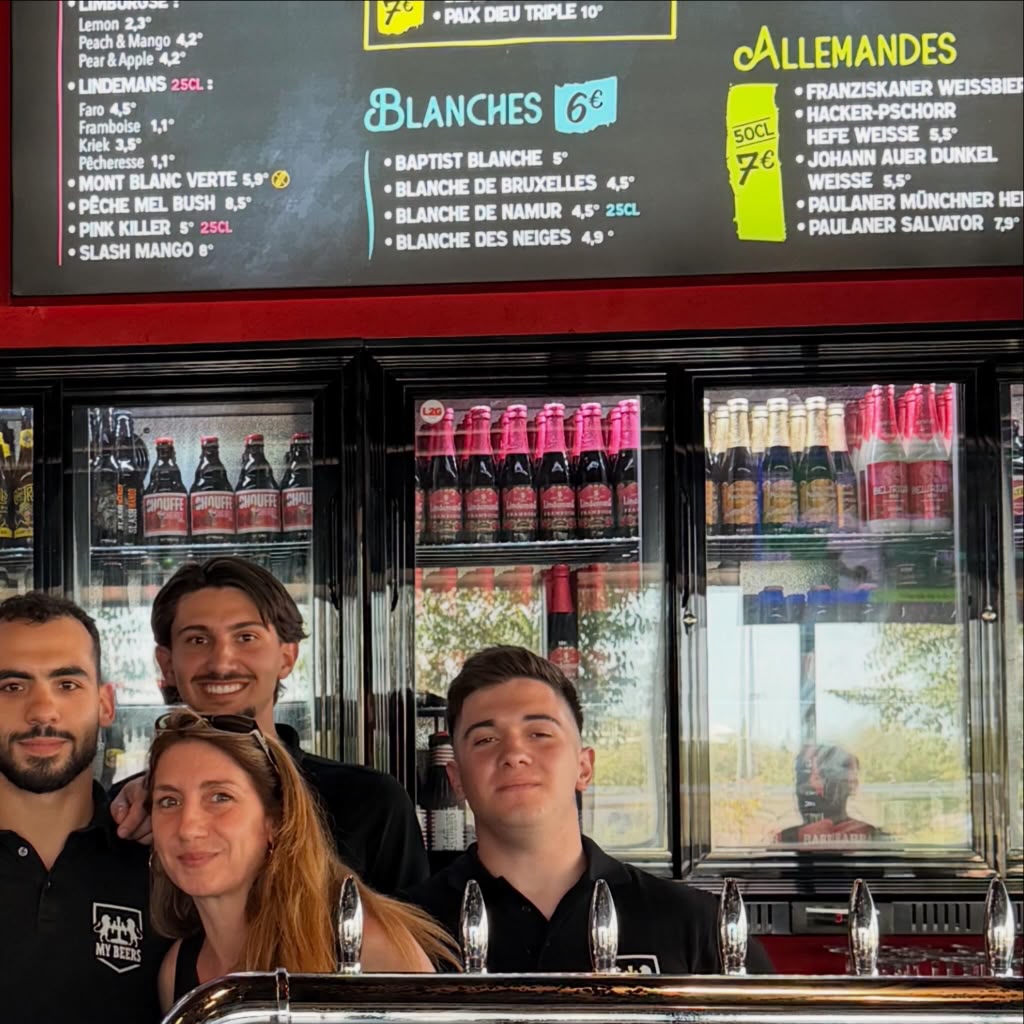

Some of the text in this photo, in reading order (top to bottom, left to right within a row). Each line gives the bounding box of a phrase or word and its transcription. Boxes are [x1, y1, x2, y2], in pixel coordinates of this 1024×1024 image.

[444, 4, 603, 24] PAIX DIEU TRIPLE 10°
[79, 18, 119, 32] Lemon
[79, 34, 113, 50] Peach
[116, 34, 125, 49] &
[128, 33, 171, 51] Mango
[79, 54, 106, 69] Pear
[108, 52, 117, 67] &
[118, 51, 154, 70] Apple
[79, 76, 204, 94] LINDEMANS 25CL
[807, 80, 933, 100] FRANZISKANER
[79, 103, 105, 117] Faro
[807, 103, 956, 122] HACKER-PSCHORR
[79, 120, 141, 134] Framboise
[734, 122, 775, 144] 50CL
[807, 127, 850, 145] HEFE
[854, 125, 920, 143] WEISSE
[79, 137, 110, 152] Kriek
[79, 155, 145, 170] Pêcheresse
[395, 153, 464, 171] BAPTIST
[467, 150, 543, 168] BLANCHE
[808, 146, 998, 168] JOHANN AUER DUNKEL
[79, 175, 124, 192] MONT
[129, 173, 182, 190] BLANC
[186, 172, 238, 189] VERTE
[396, 179, 470, 197] BLANCHE
[474, 178, 497, 195] DE
[501, 175, 597, 194] BRUXELLES
[808, 172, 873, 190] WEISSE
[79, 195, 130, 214] PÊCHE
[134, 197, 168, 212] MEL
[172, 195, 216, 211] BUSH
[808, 189, 1024, 213] PAULANER MÜNCHNER HE
[396, 205, 470, 224] BLANCHE
[475, 204, 497, 221] DE
[502, 202, 562, 220] NAMUR
[606, 203, 640, 217] 25CL
[79, 222, 114, 238] PINK
[118, 220, 171, 236] KILLER
[200, 221, 233, 234] 25CL
[809, 217, 896, 235] PAULANER
[901, 215, 984, 234] SALVATOR
[396, 232, 471, 250] BLANCHE
[475, 230, 508, 247] DES
[513, 229, 572, 246] NEIGES
[79, 244, 131, 260] SLASH
[135, 242, 194, 259] MANGO
[96, 942, 141, 962] MY BEERS
